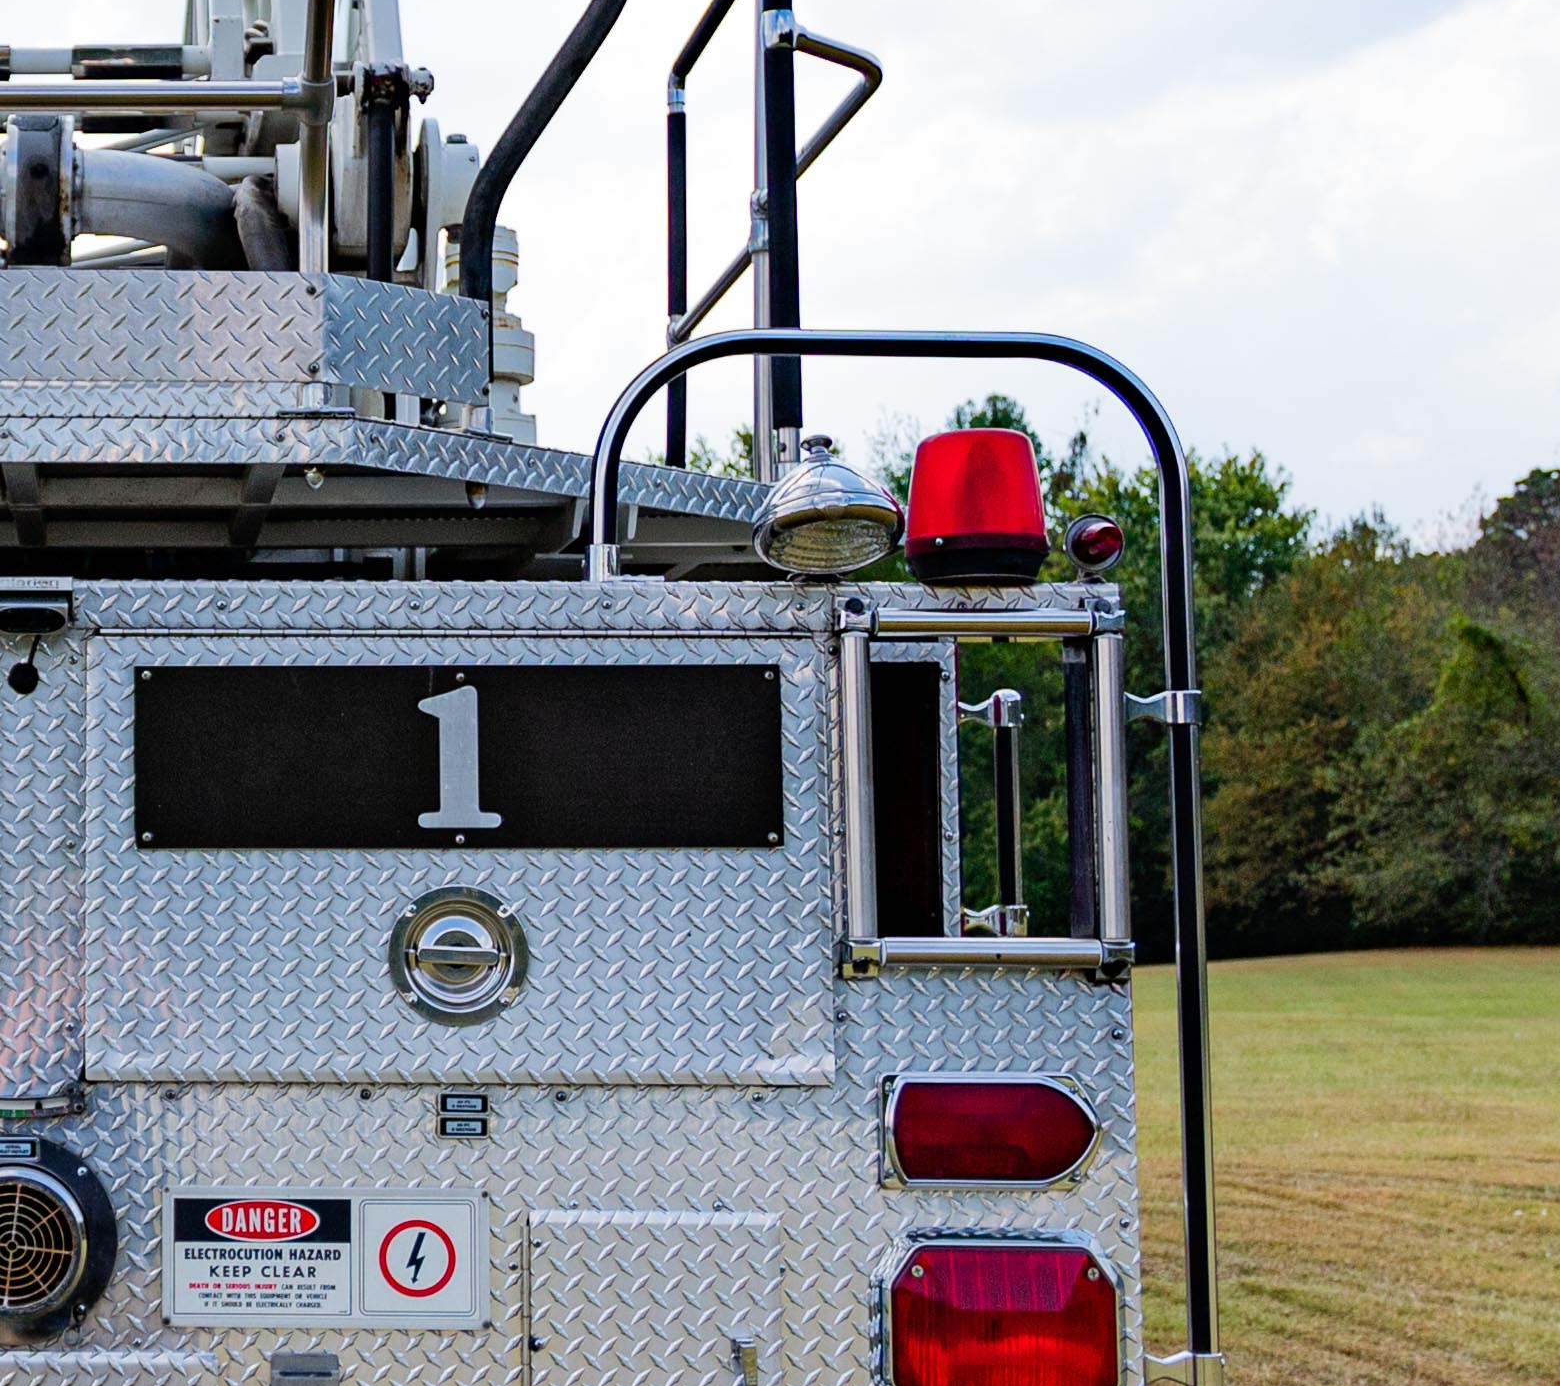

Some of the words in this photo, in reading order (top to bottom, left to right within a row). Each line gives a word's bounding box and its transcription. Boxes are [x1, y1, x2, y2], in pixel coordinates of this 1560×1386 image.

[417, 685, 502, 829] 1
[221, 1207, 302, 1233] DANGER
[184, 1248, 283, 1261] ELECTROCUTION
[289, 1249, 342, 1261] HAZARD
[209, 1265, 252, 1278] KEEP
[261, 1266, 317, 1278] CLEAR
